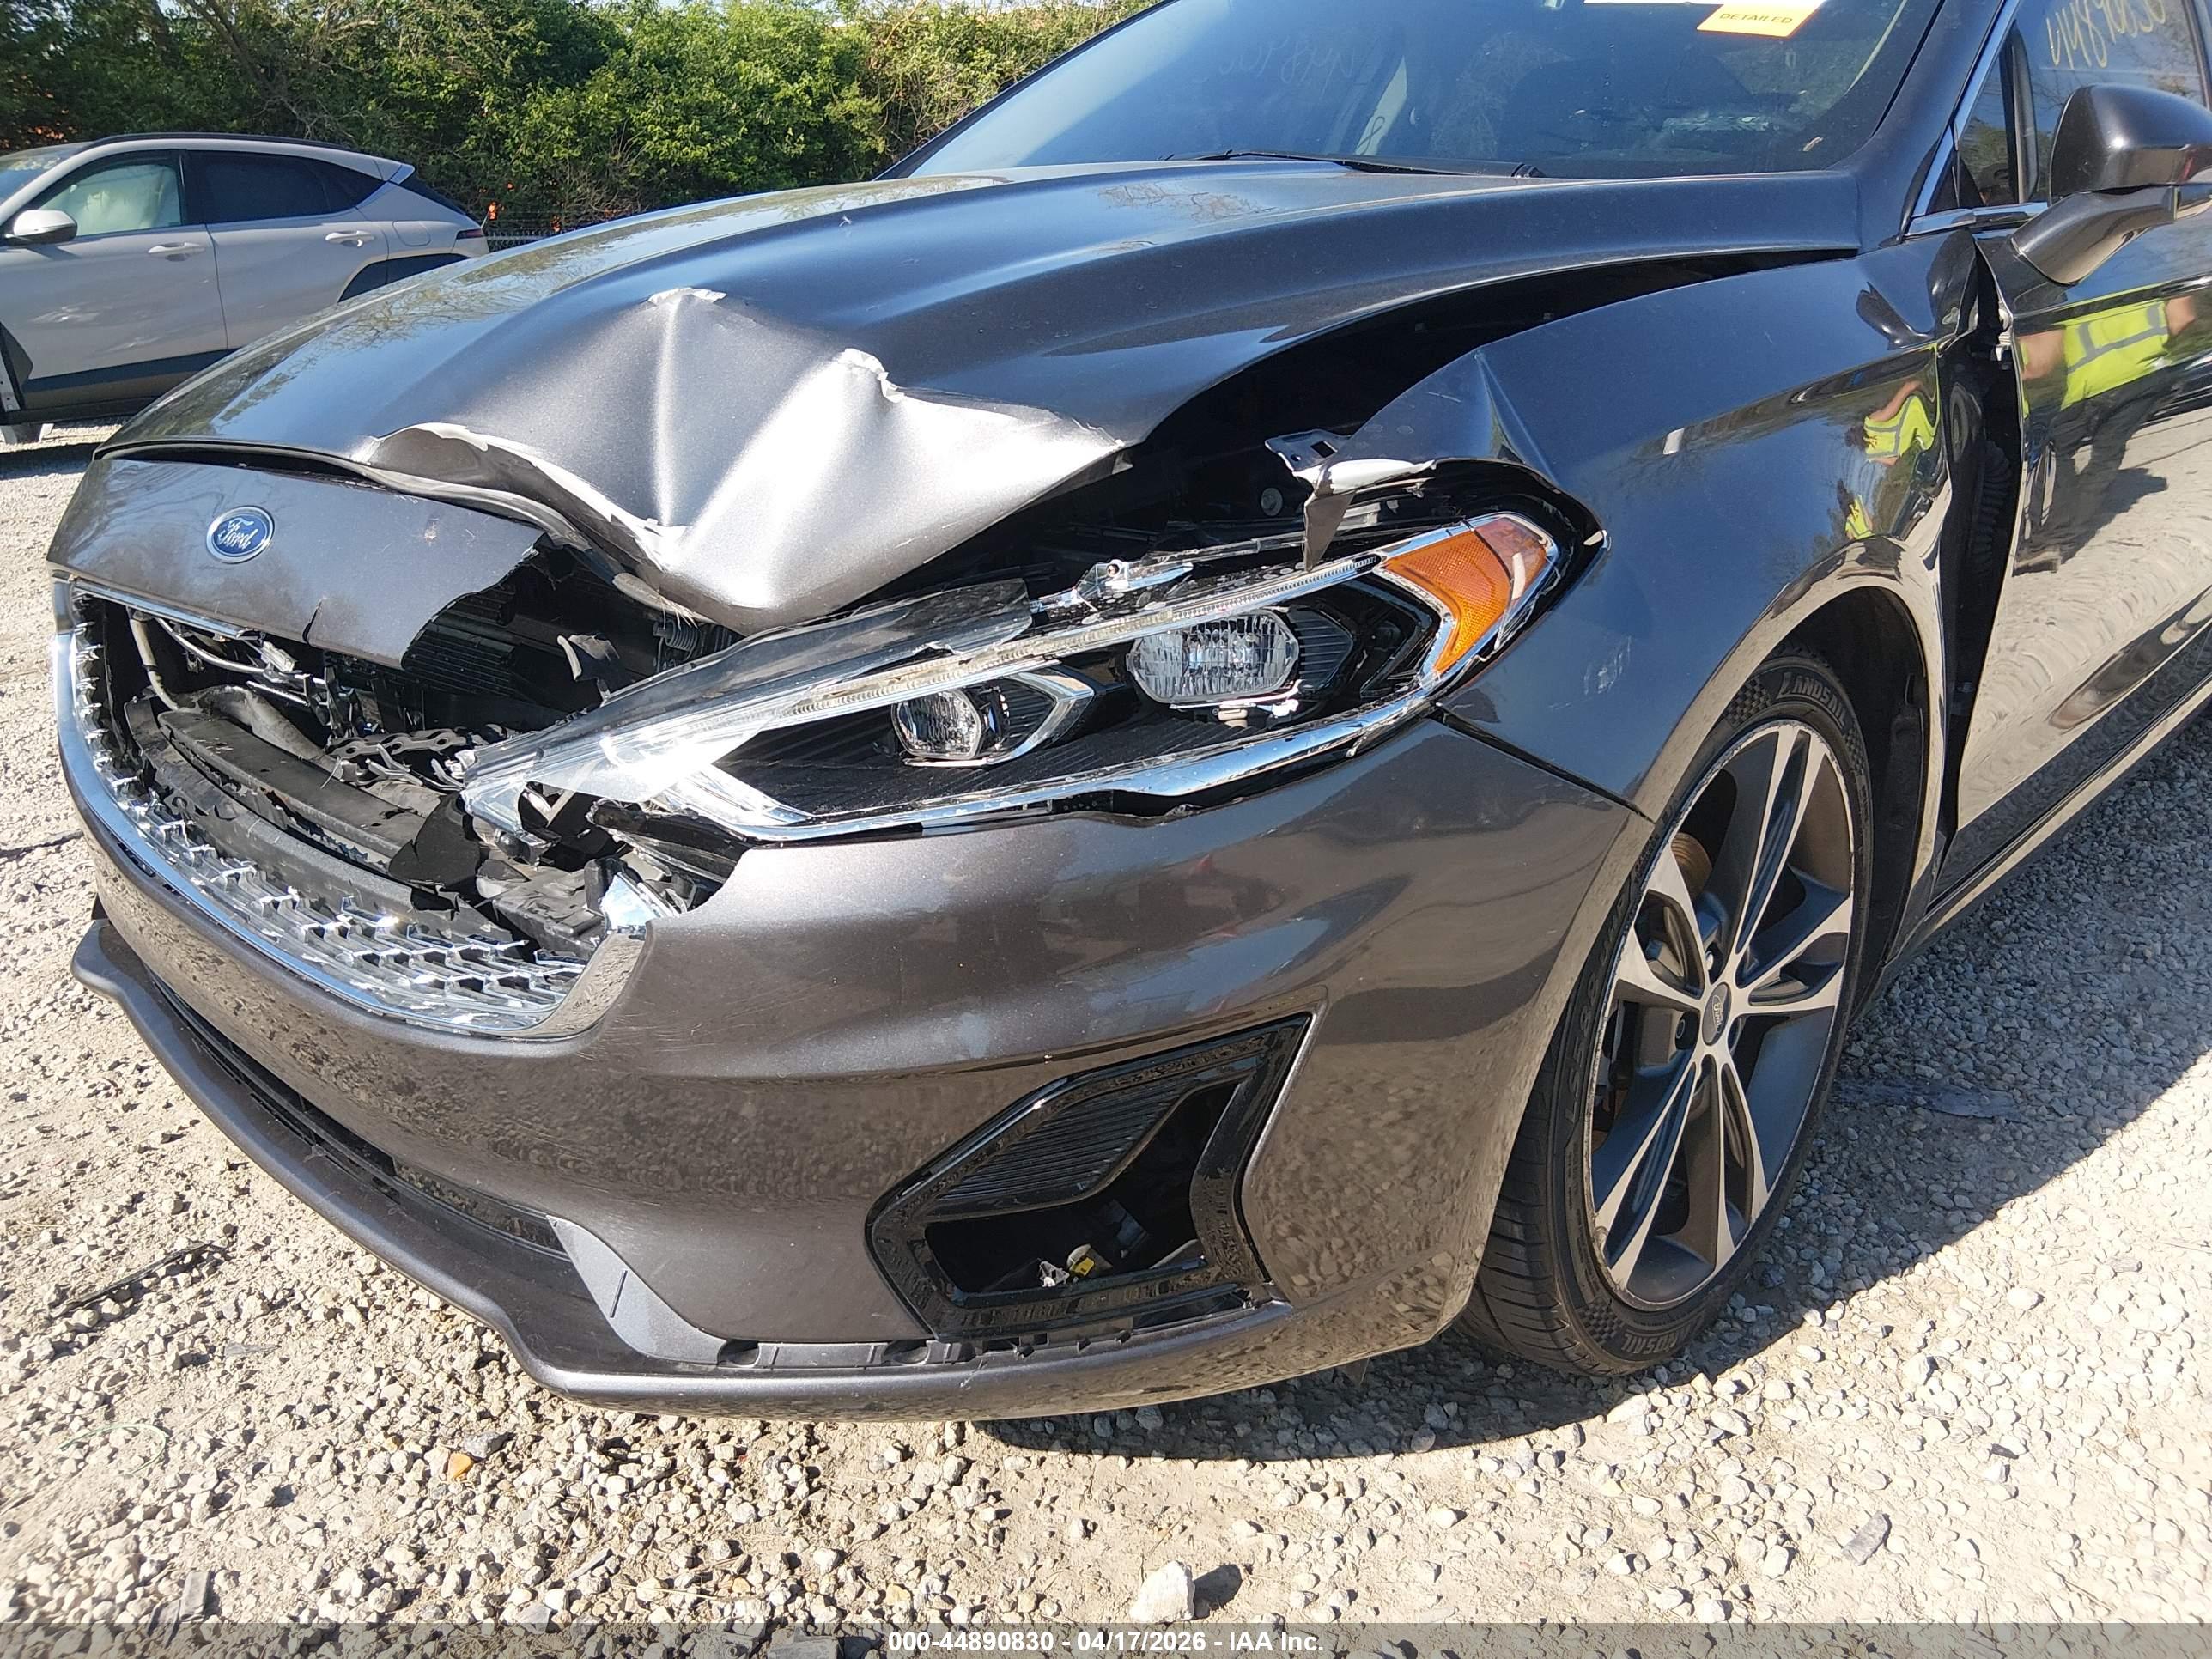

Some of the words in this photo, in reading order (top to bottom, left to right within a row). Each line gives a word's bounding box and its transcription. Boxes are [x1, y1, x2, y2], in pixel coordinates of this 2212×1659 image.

[1719, 13, 1793, 24] DETAILED
[217, 517, 258, 550] Ford
[1776, 672, 1846, 730] LANDSAIL
